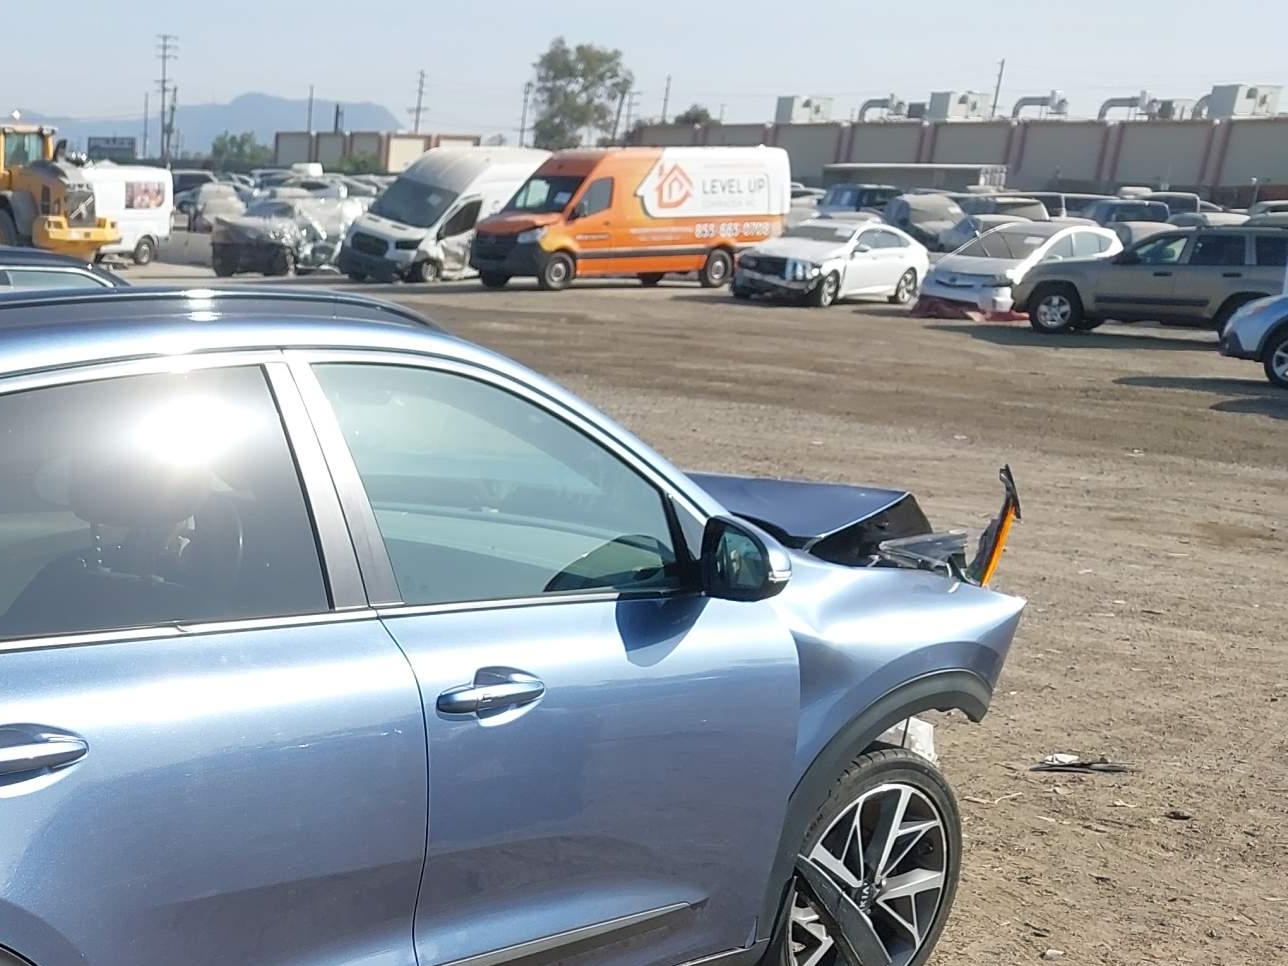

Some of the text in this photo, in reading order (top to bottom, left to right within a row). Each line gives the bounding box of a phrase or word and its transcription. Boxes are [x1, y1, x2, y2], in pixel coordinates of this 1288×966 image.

[702, 178, 765, 194] LEVEL UP
[859, 886, 870, 908] KIA
